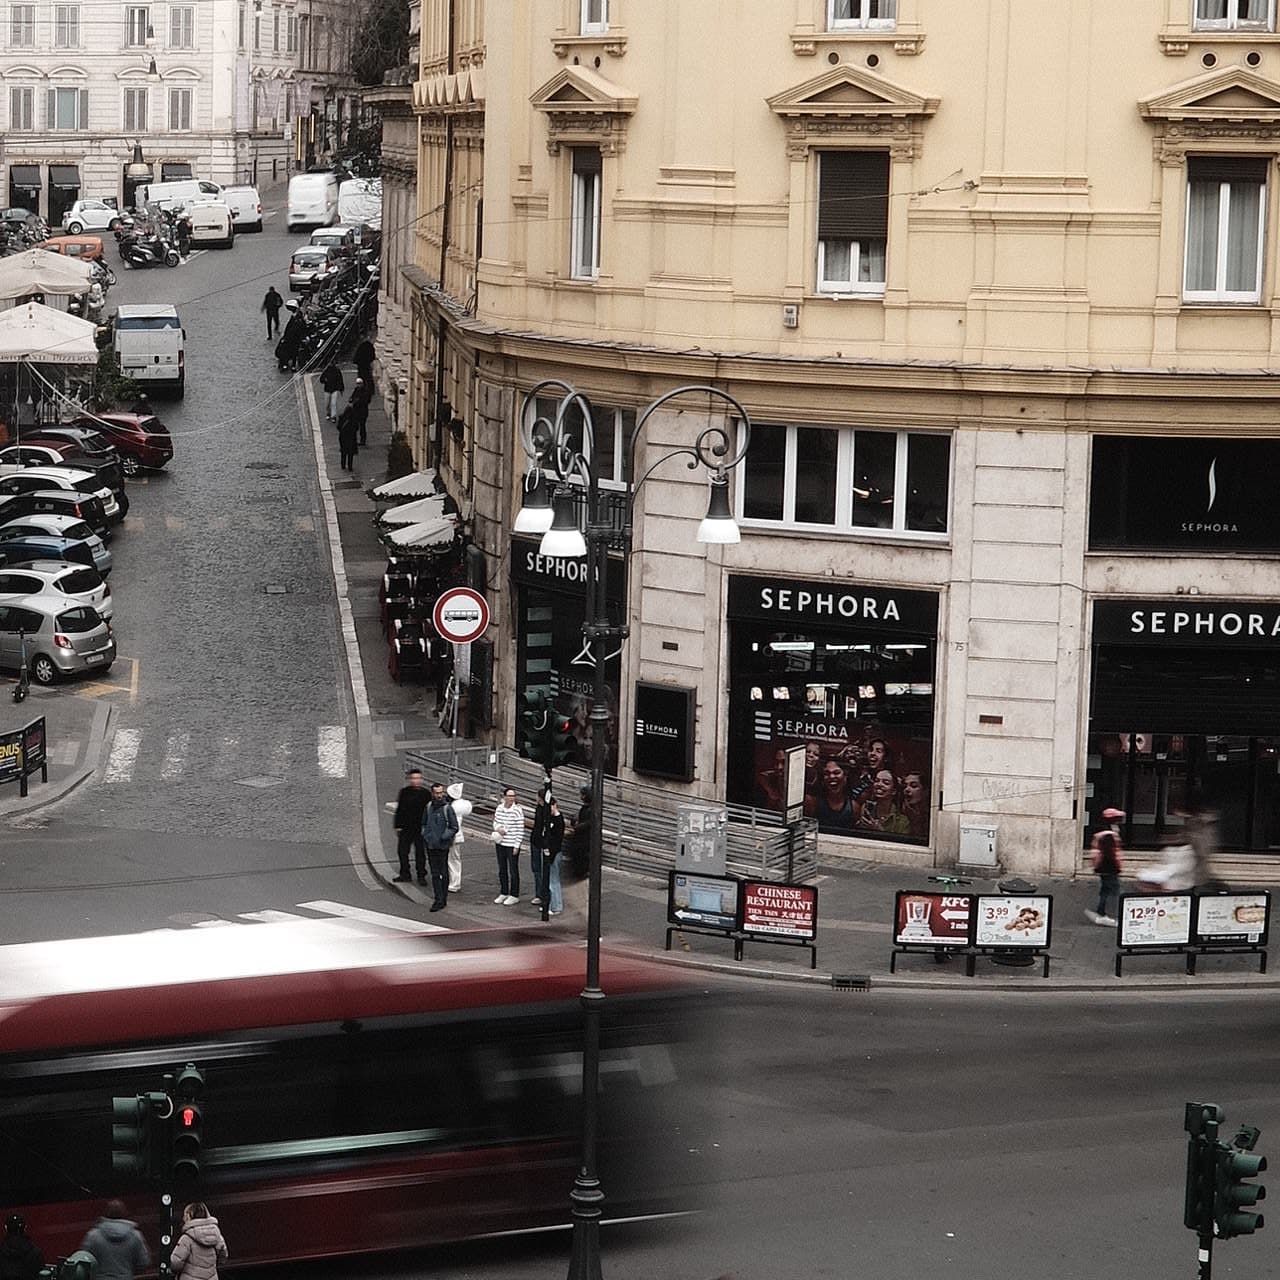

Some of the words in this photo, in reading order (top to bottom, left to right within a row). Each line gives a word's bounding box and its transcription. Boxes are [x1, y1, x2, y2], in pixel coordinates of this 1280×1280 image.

[1181, 522, 1239, 532] SEPHORA
[760, 587, 901, 621] SEPHORA
[645, 723, 679, 735] SEPHORA
[776, 719, 849, 738] SEPHORA
[757, 887, 802, 900] CHINESE
[746, 896, 813, 911] RESTAURANT
[940, 896, 970, 908] KFC
